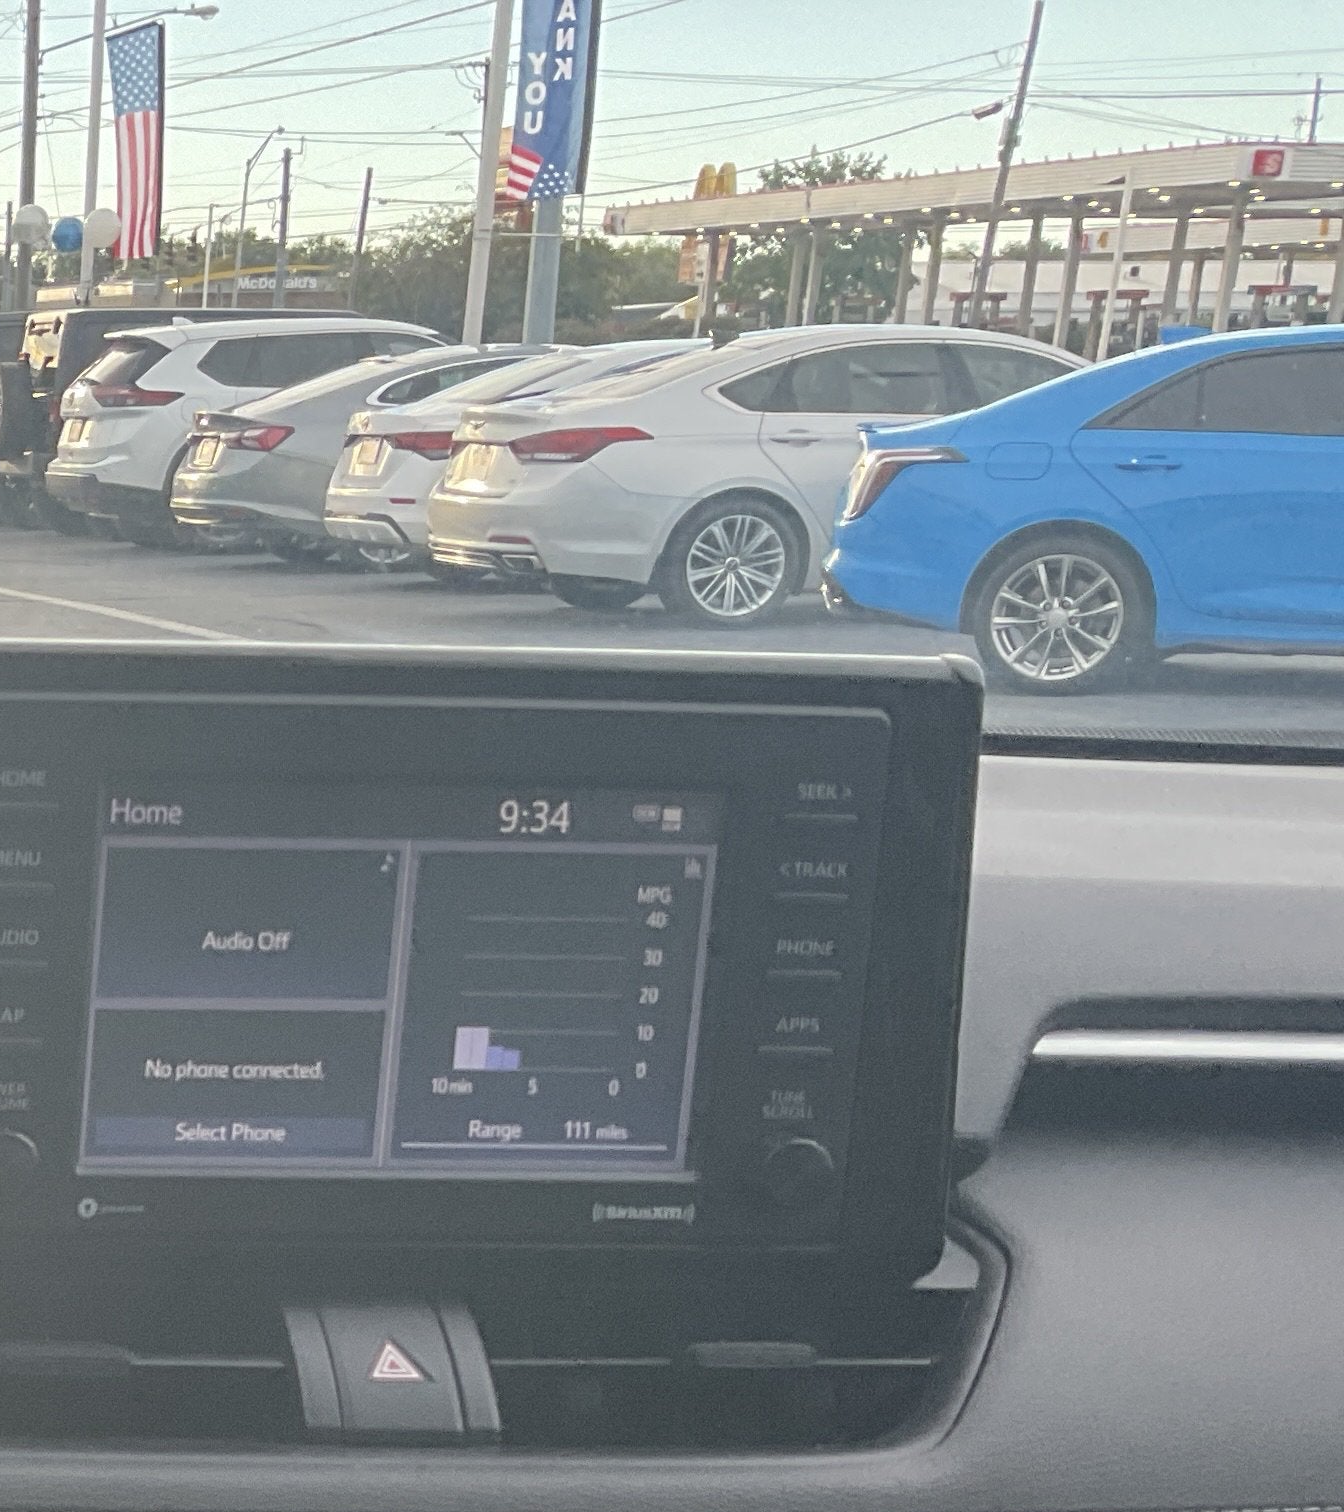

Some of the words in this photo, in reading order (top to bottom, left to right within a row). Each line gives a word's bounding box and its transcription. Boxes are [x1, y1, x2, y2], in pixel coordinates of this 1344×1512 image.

[237, 275, 318, 289] McDoald's
[110, 797, 183, 825] Home
[499, 801, 571, 834] 9:34
[637, 886, 673, 904] MPG
[646, 912, 668, 929] 40
[202, 931, 253, 951] Audio
[258, 931, 291, 951] Off
[776, 939, 835, 956] PHONE
[643, 950, 663, 967] 30
[639, 988, 659, 1004] 20
[637, 1025, 654, 1041] 10
[144, 1058, 172, 1079] No
[176, 1059, 229, 1082] phone
[635, 1063, 647, 1079] 0
[432, 1078, 448, 1094] 10
[449, 1078, 473, 1094] min
[527, 1079, 538, 1095] 5
[608, 1079, 619, 1096] 0
[175, 1122, 227, 1141] Select
[231, 1123, 287, 1142] Phone
[468, 1120, 522, 1141] Range
[564, 1121, 590, 1139] 111
